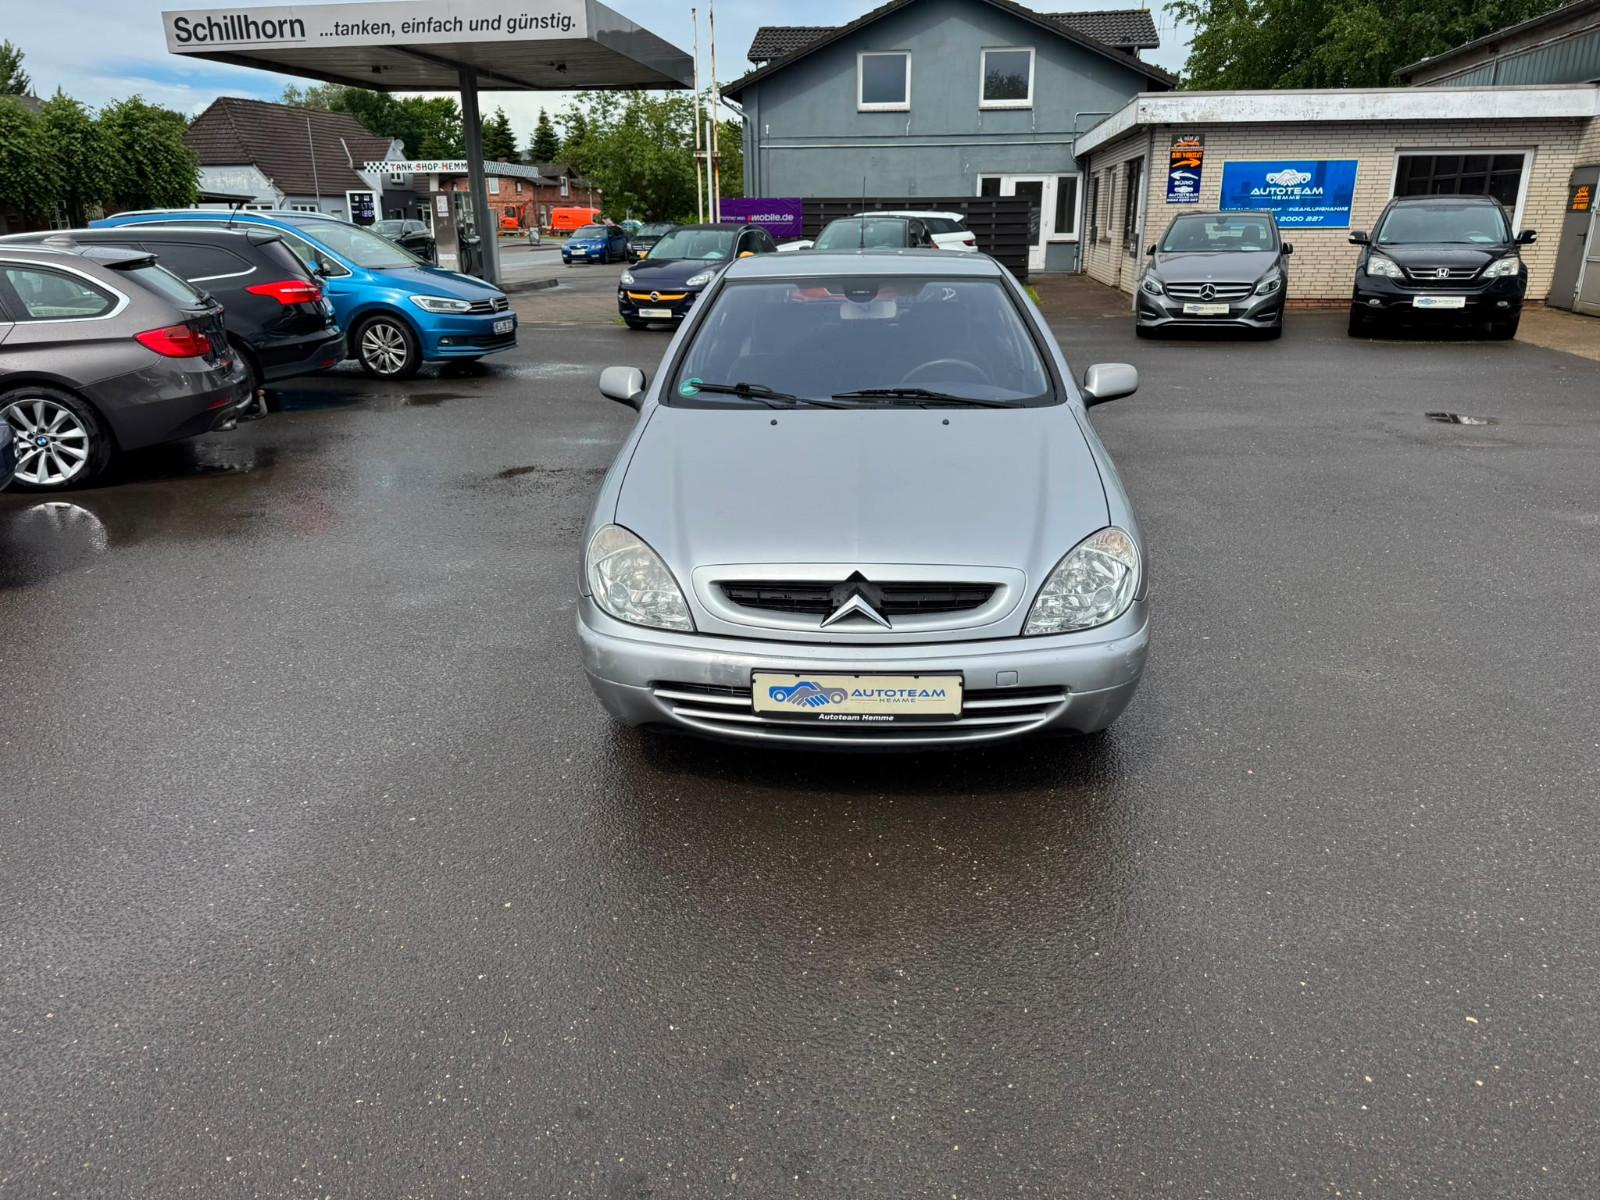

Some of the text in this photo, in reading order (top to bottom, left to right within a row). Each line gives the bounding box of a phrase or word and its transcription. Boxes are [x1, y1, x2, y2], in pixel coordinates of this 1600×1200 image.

[173, 14, 306, 43] Schillhorn
[401, 16, 463, 34] einfach
[469, 14, 502, 32] und
[506, 12, 577, 34] günstig.
[1250, 187, 1323, 195] AUTOTEAM
[751, 213, 794, 221] mobile.de
[851, 688, 946, 698] AUTOTEAM
[818, 713, 895, 722] Autoteam Hemme
